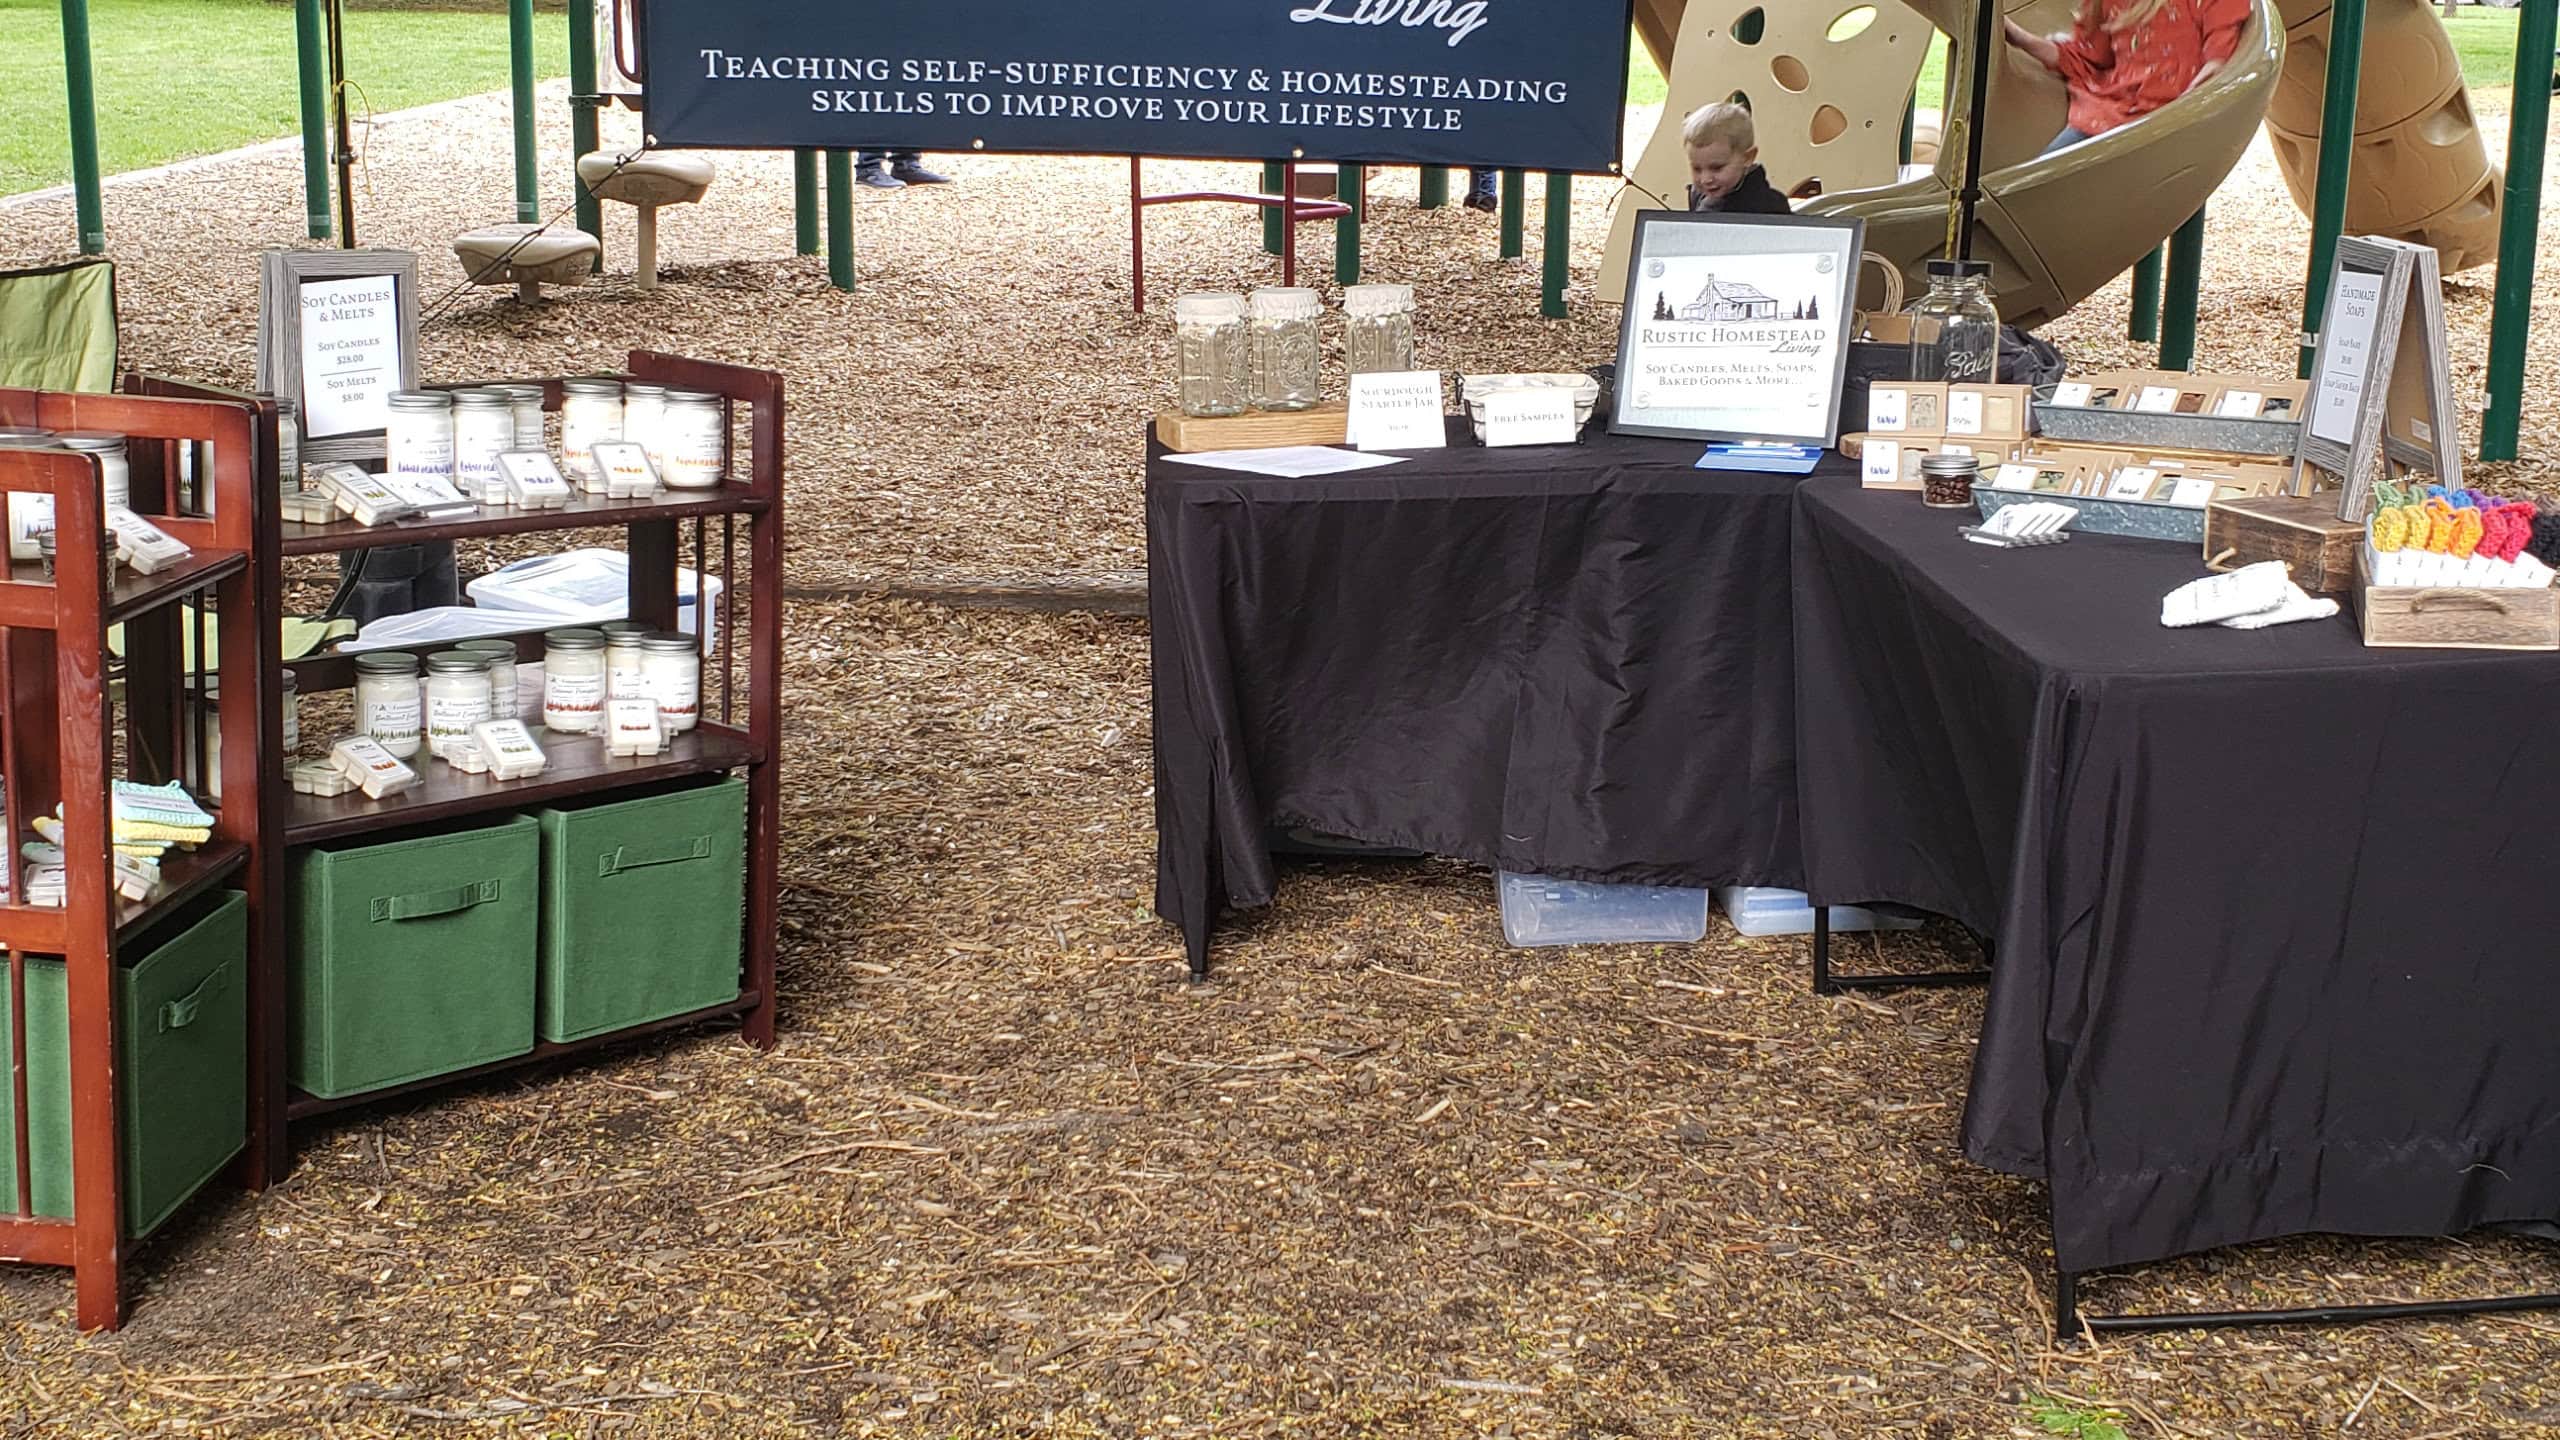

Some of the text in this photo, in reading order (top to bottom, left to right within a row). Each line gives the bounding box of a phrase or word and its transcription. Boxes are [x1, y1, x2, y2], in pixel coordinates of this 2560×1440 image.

[701, 49, 1568, 103] TEACHING SELF-SUFFICIENCY & HOMESTEADING
[811, 90, 1463, 131] SKILLS TO IMPROVE YOUR LIFESTYLE
[302, 290, 391, 309] SOY CANDLES
[2340, 284, 2376, 302] HANDMADE
[319, 308, 375, 322] & MELTS
[2345, 302, 2366, 318] SOAPS
[1642, 327, 1826, 344] RUSTIC HOMESTEAD
[318, 337, 380, 352] SOY CANDLES
[1769, 340, 1822, 357] Living
[1646, 363, 1668, 374] SOY
[327, 376, 377, 389] SOY MELTS
[1658, 375, 1698, 386] BAKED
[1700, 375, 1742, 386] GOODS
[1360, 386, 1433, 396] SOURDOUGH
[1361, 397, 1435, 409] STARTER JAR
